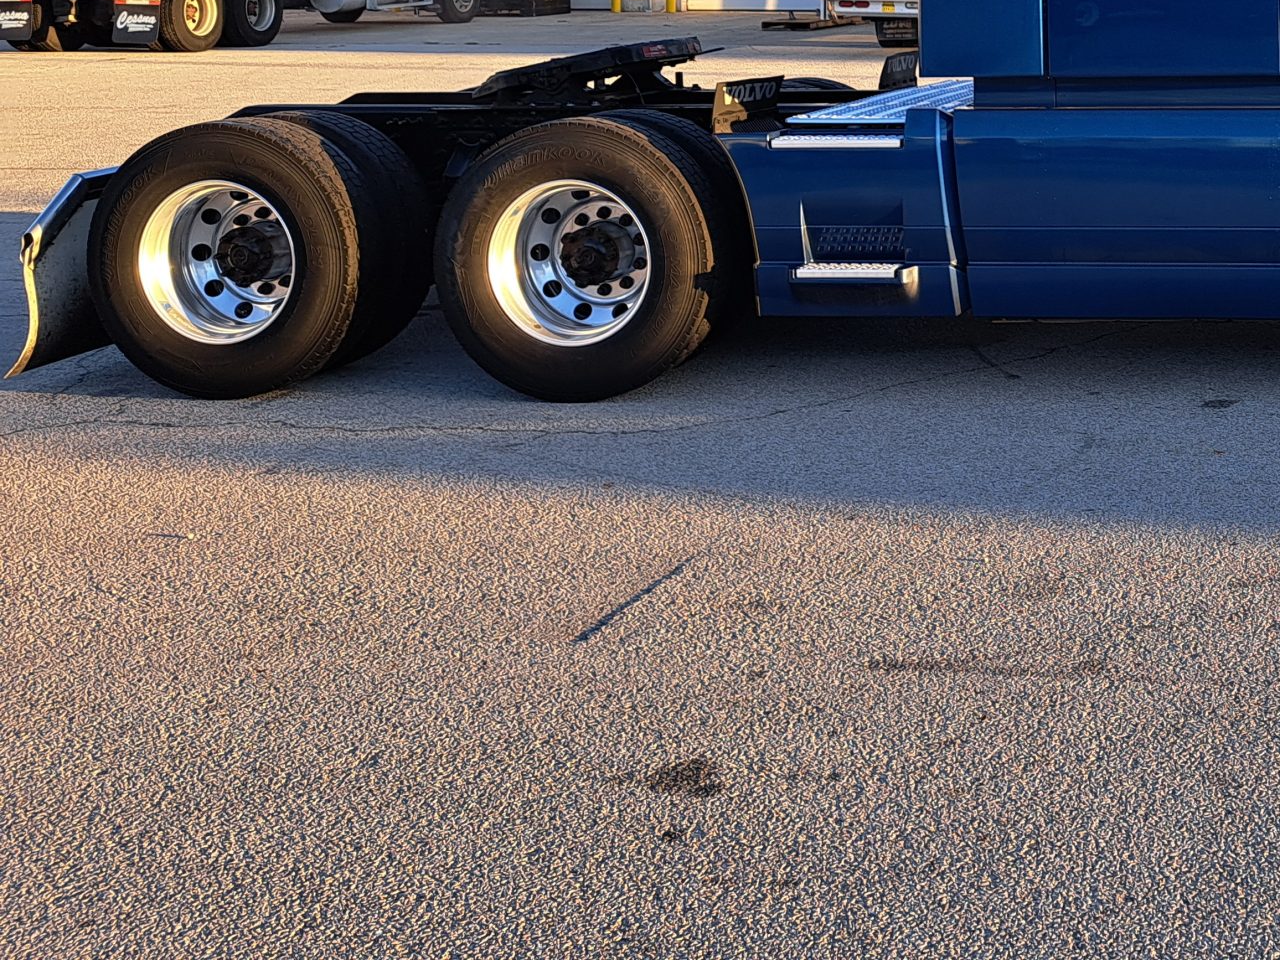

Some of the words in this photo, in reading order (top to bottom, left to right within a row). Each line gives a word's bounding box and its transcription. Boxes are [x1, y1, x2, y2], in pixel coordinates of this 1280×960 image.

[116, 10, 157, 29] Cessna
[887, 54, 915, 73] VOLVO
[722, 81, 776, 105] VOLVO
